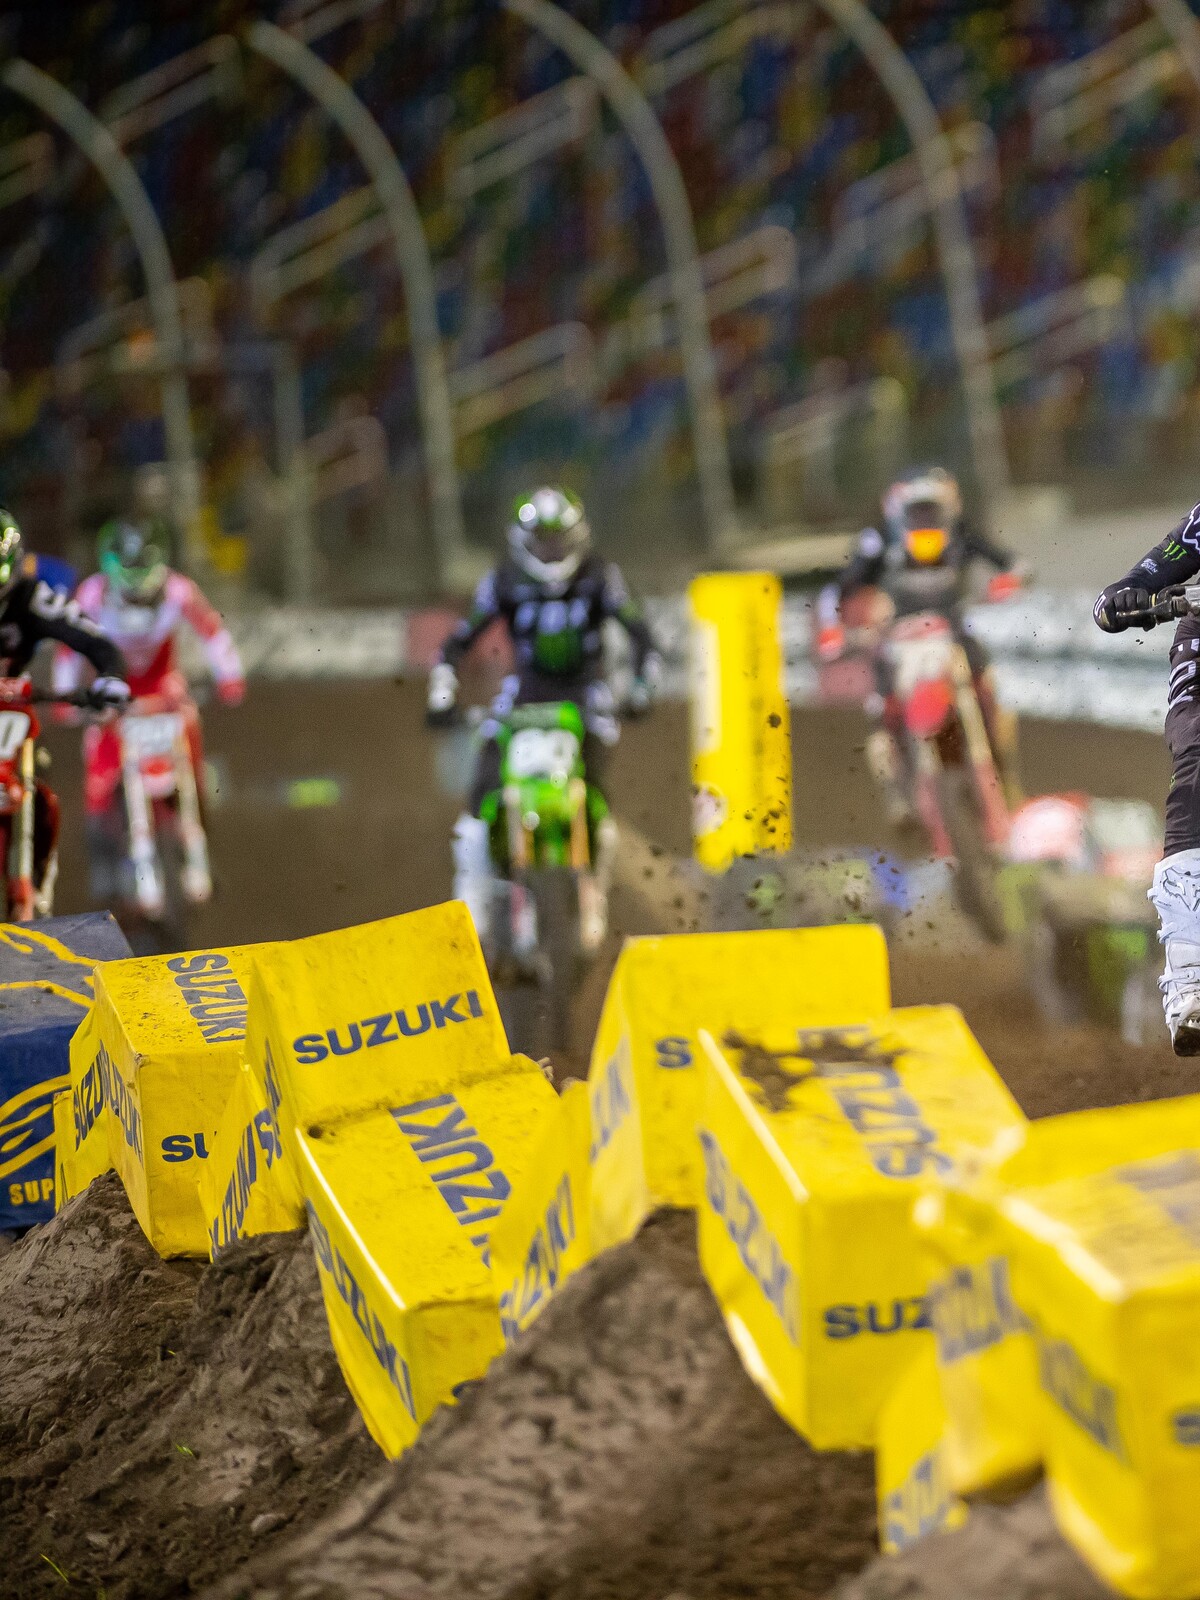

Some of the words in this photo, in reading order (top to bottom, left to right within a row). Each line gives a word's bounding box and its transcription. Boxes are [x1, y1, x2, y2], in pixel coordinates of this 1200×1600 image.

[166, 953, 249, 1044] SUZUKI
[293, 989, 484, 1064] SUZUKI
[9, 1178, 54, 1206] SUP
[387, 1092, 513, 1270] ZUKI
[823, 1300, 933, 1341] SUZ
